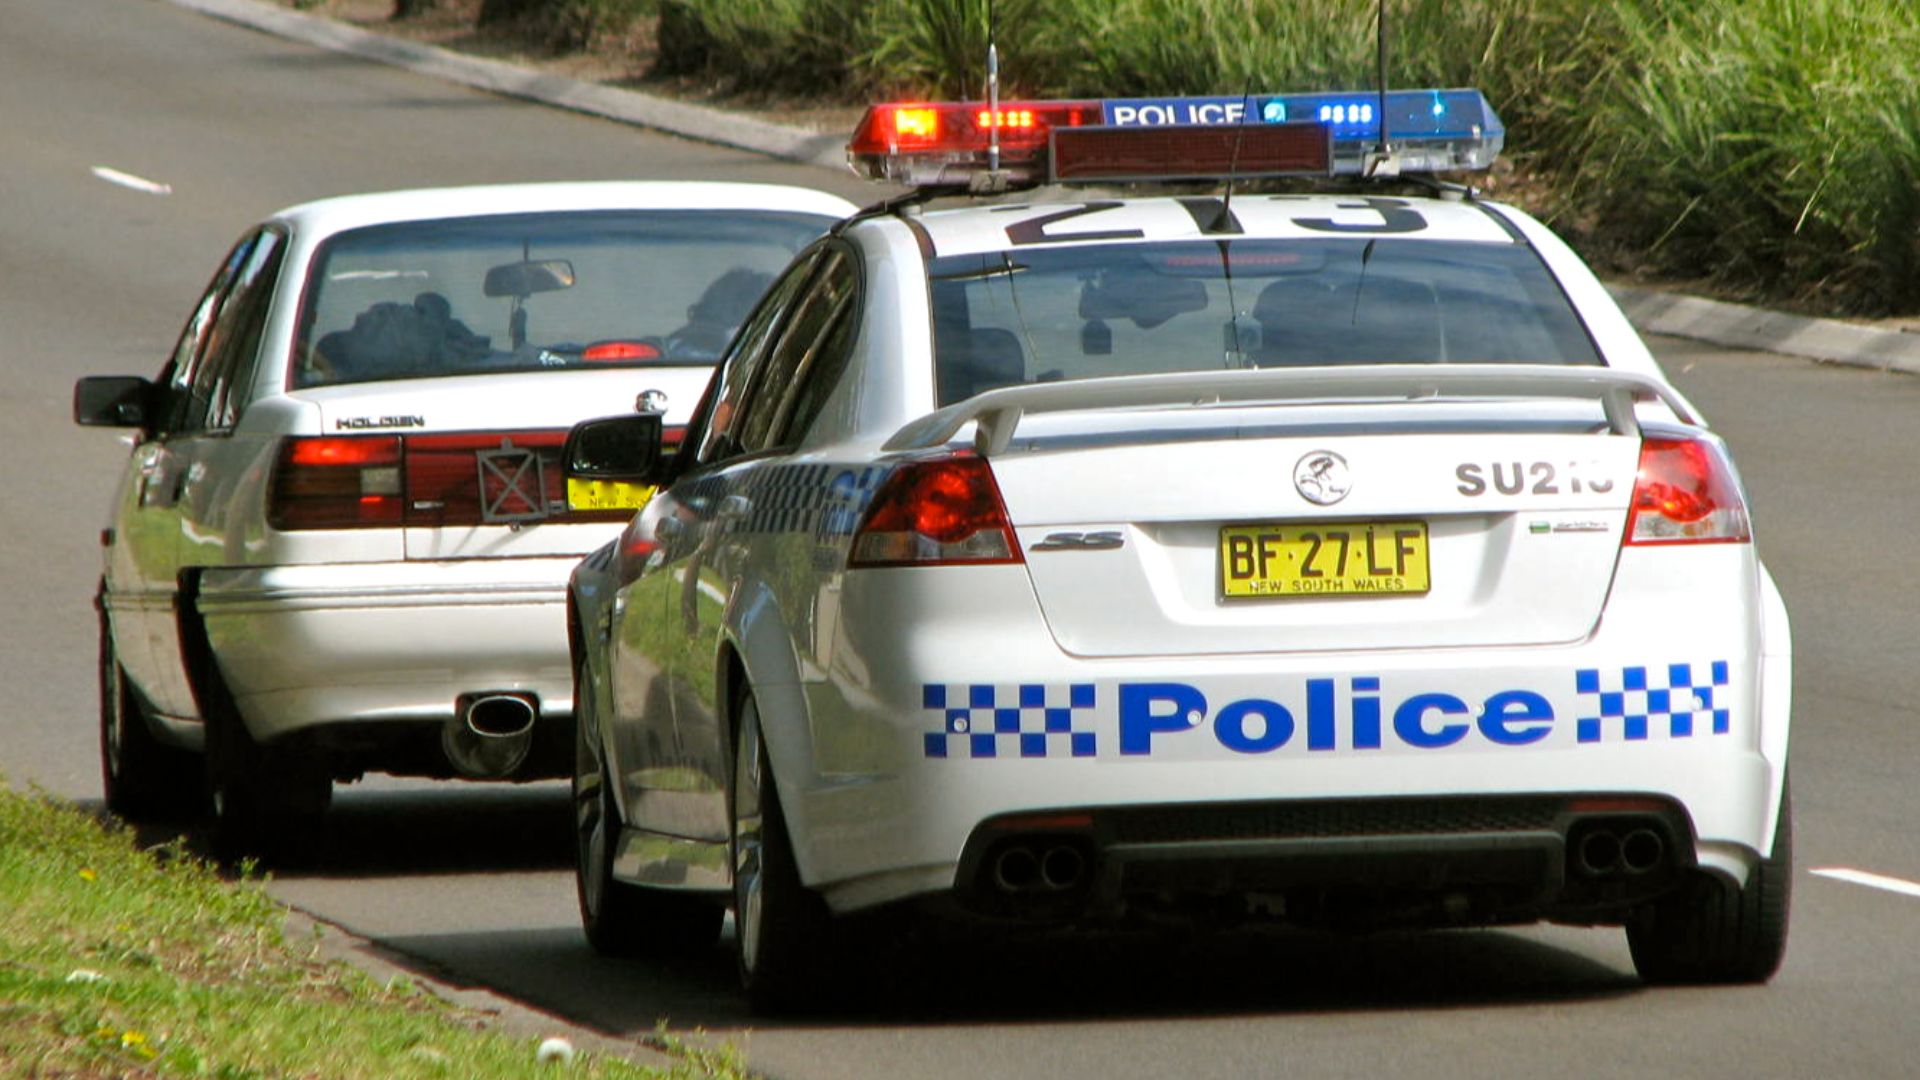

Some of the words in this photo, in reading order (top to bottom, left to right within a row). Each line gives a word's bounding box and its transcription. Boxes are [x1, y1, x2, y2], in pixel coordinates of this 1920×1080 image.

[1114, 103, 1246, 126] POLICE
[336, 415, 424, 430] HOLDEN
[1251, 581, 1282, 593] NEW
[1292, 579, 1344, 592] SOUTH
[1354, 578, 1404, 590] WALES
[1119, 677, 1554, 756] Police
